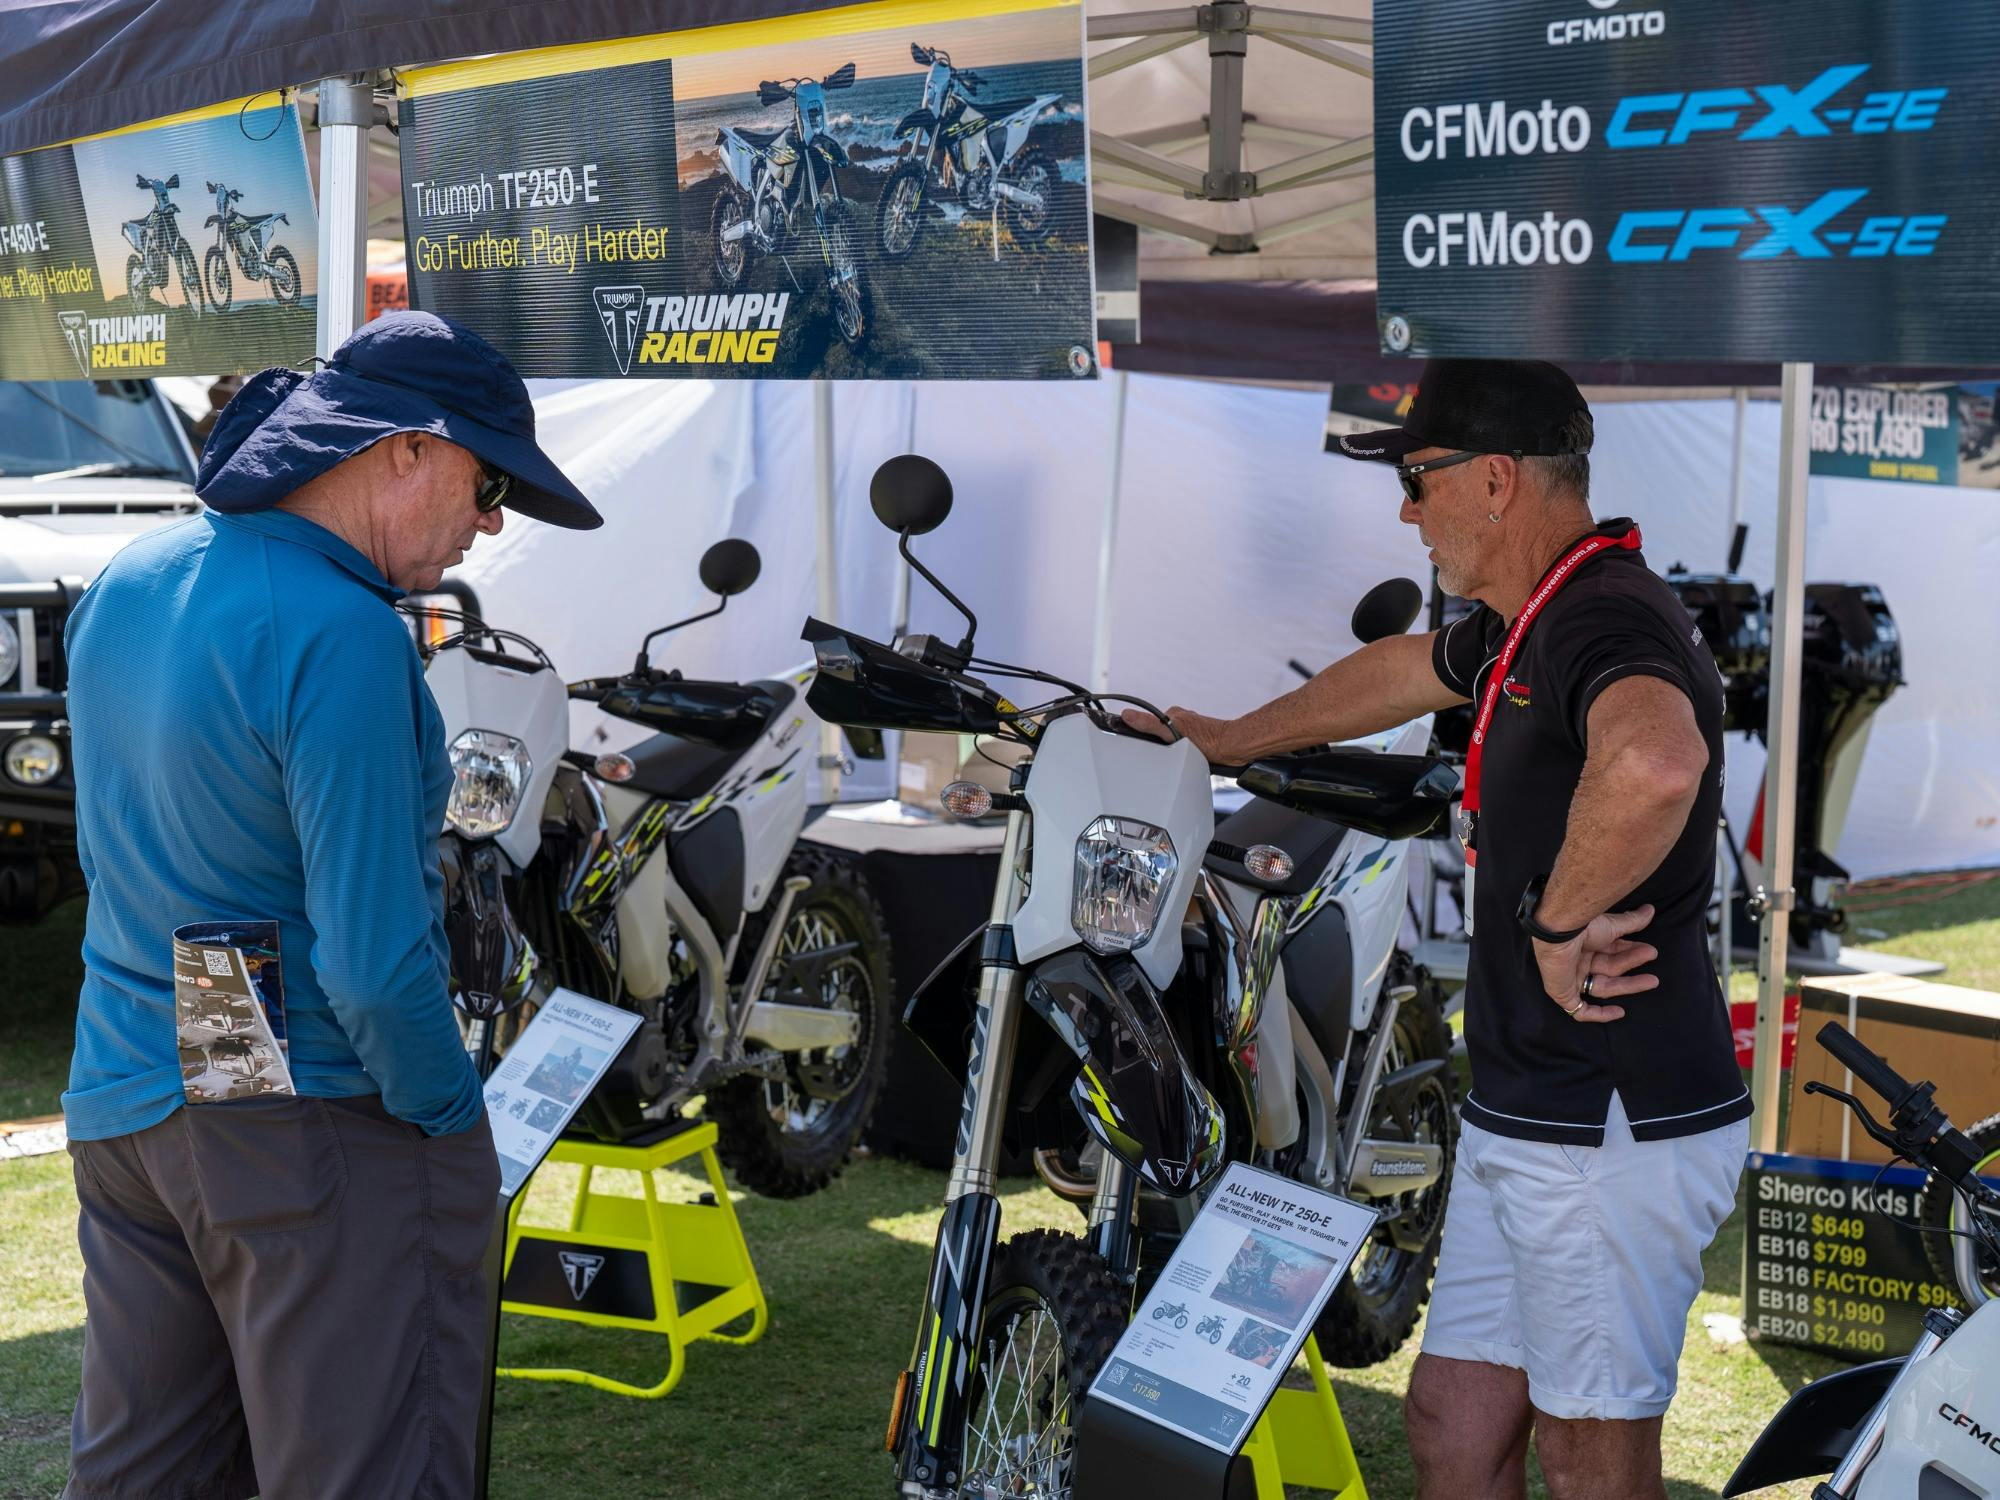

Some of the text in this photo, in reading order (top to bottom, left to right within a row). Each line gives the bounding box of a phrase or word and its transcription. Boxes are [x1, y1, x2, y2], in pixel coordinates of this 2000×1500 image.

[1547, 11, 1665, 45] CFMOTO
[1400, 63, 1949, 162] CFMoto CFX-2E
[412, 164, 600, 221] Triumph TF250-E
[416, 219, 669, 274] Go Further. Play Harder
[1402, 210, 1594, 268] CFMoto
[16, 266, 46, 304] Play
[44, 260, 94, 295] Harder
[602, 293, 635, 304] TRIUMPH
[88, 313, 167, 345] TRIUMPH
[645, 292, 790, 332] TRIUMPH
[91, 341, 166, 369] RACING
[638, 331, 781, 364] RACING
[1843, 388, 1949, 430] EXPLORER
[1842, 423, 1926, 459] $11,490
[1501, 541, 1599, 666] www.australianevents.com.au
[1371, 1159, 1426, 1176] #sunstatemc
[1226, 1183, 1332, 1228] ALL-NEW TF 250-E
[1758, 1175, 1845, 1209] Sherco
[1851, 1186, 1908, 1217] Kids
[1230, 1208, 1241, 1216] THE
[1240, 1212, 1261, 1223] BETTER
[1267, 1221, 1281, 1231] GETS
[1255, 1209, 1271, 1218] PLAY
[1296, 1224, 1308, 1232] THE
[1309, 1228, 1336, 1242] TOUGHER
[1337, 1238, 1349, 1247] THE
[1758, 1207, 1865, 1239] EB12 $649
[1758, 1234, 1867, 1267] EB16 $799
[1758, 1261, 1810, 1287] EB16
[1812, 1268, 1914, 1301] FACTORY
[1758, 1288, 1885, 1326] EB18 $1,990
[1758, 1314, 1885, 1353] EB20 $2,490
[1236, 1374, 1251, 1386] 20
